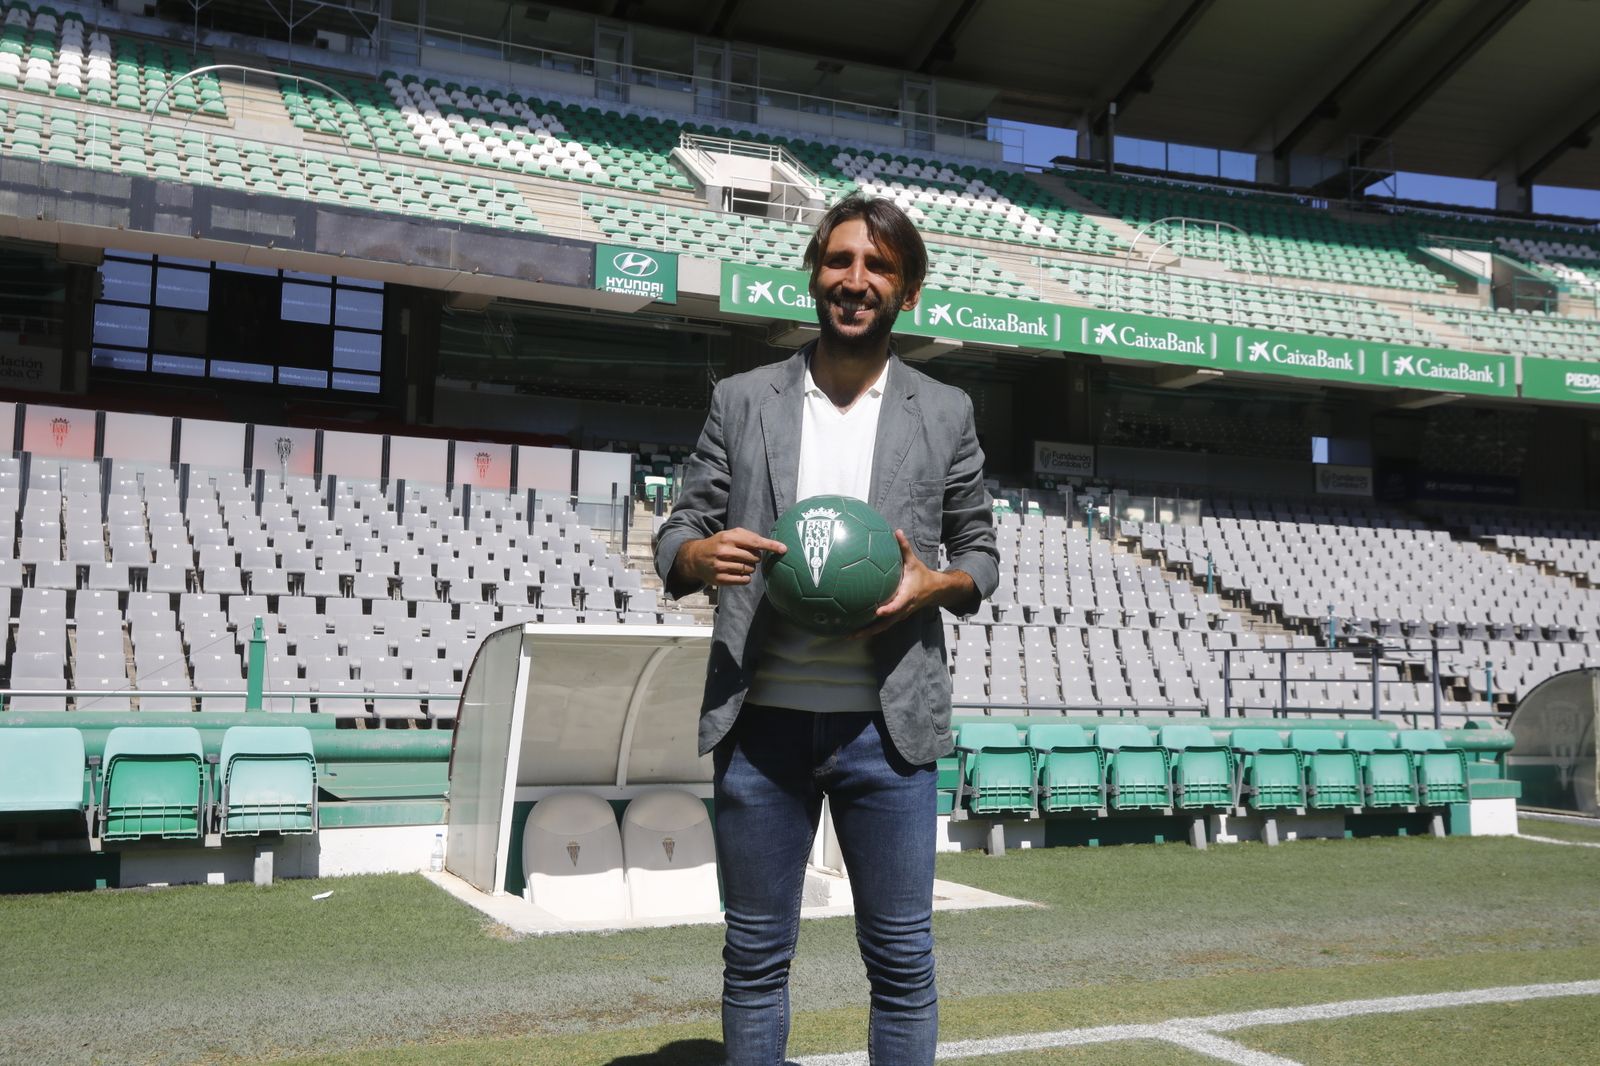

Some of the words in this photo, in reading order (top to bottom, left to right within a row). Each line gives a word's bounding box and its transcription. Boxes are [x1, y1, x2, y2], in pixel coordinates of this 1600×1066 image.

[606, 276, 664, 293] HYUNDAI
[956, 307, 1048, 337] CaixaBank
[1120, 326, 1206, 355] CaixaBank
[1272, 344, 1353, 371] CaixaBank
[1416, 358, 1494, 383] CaixaBank
